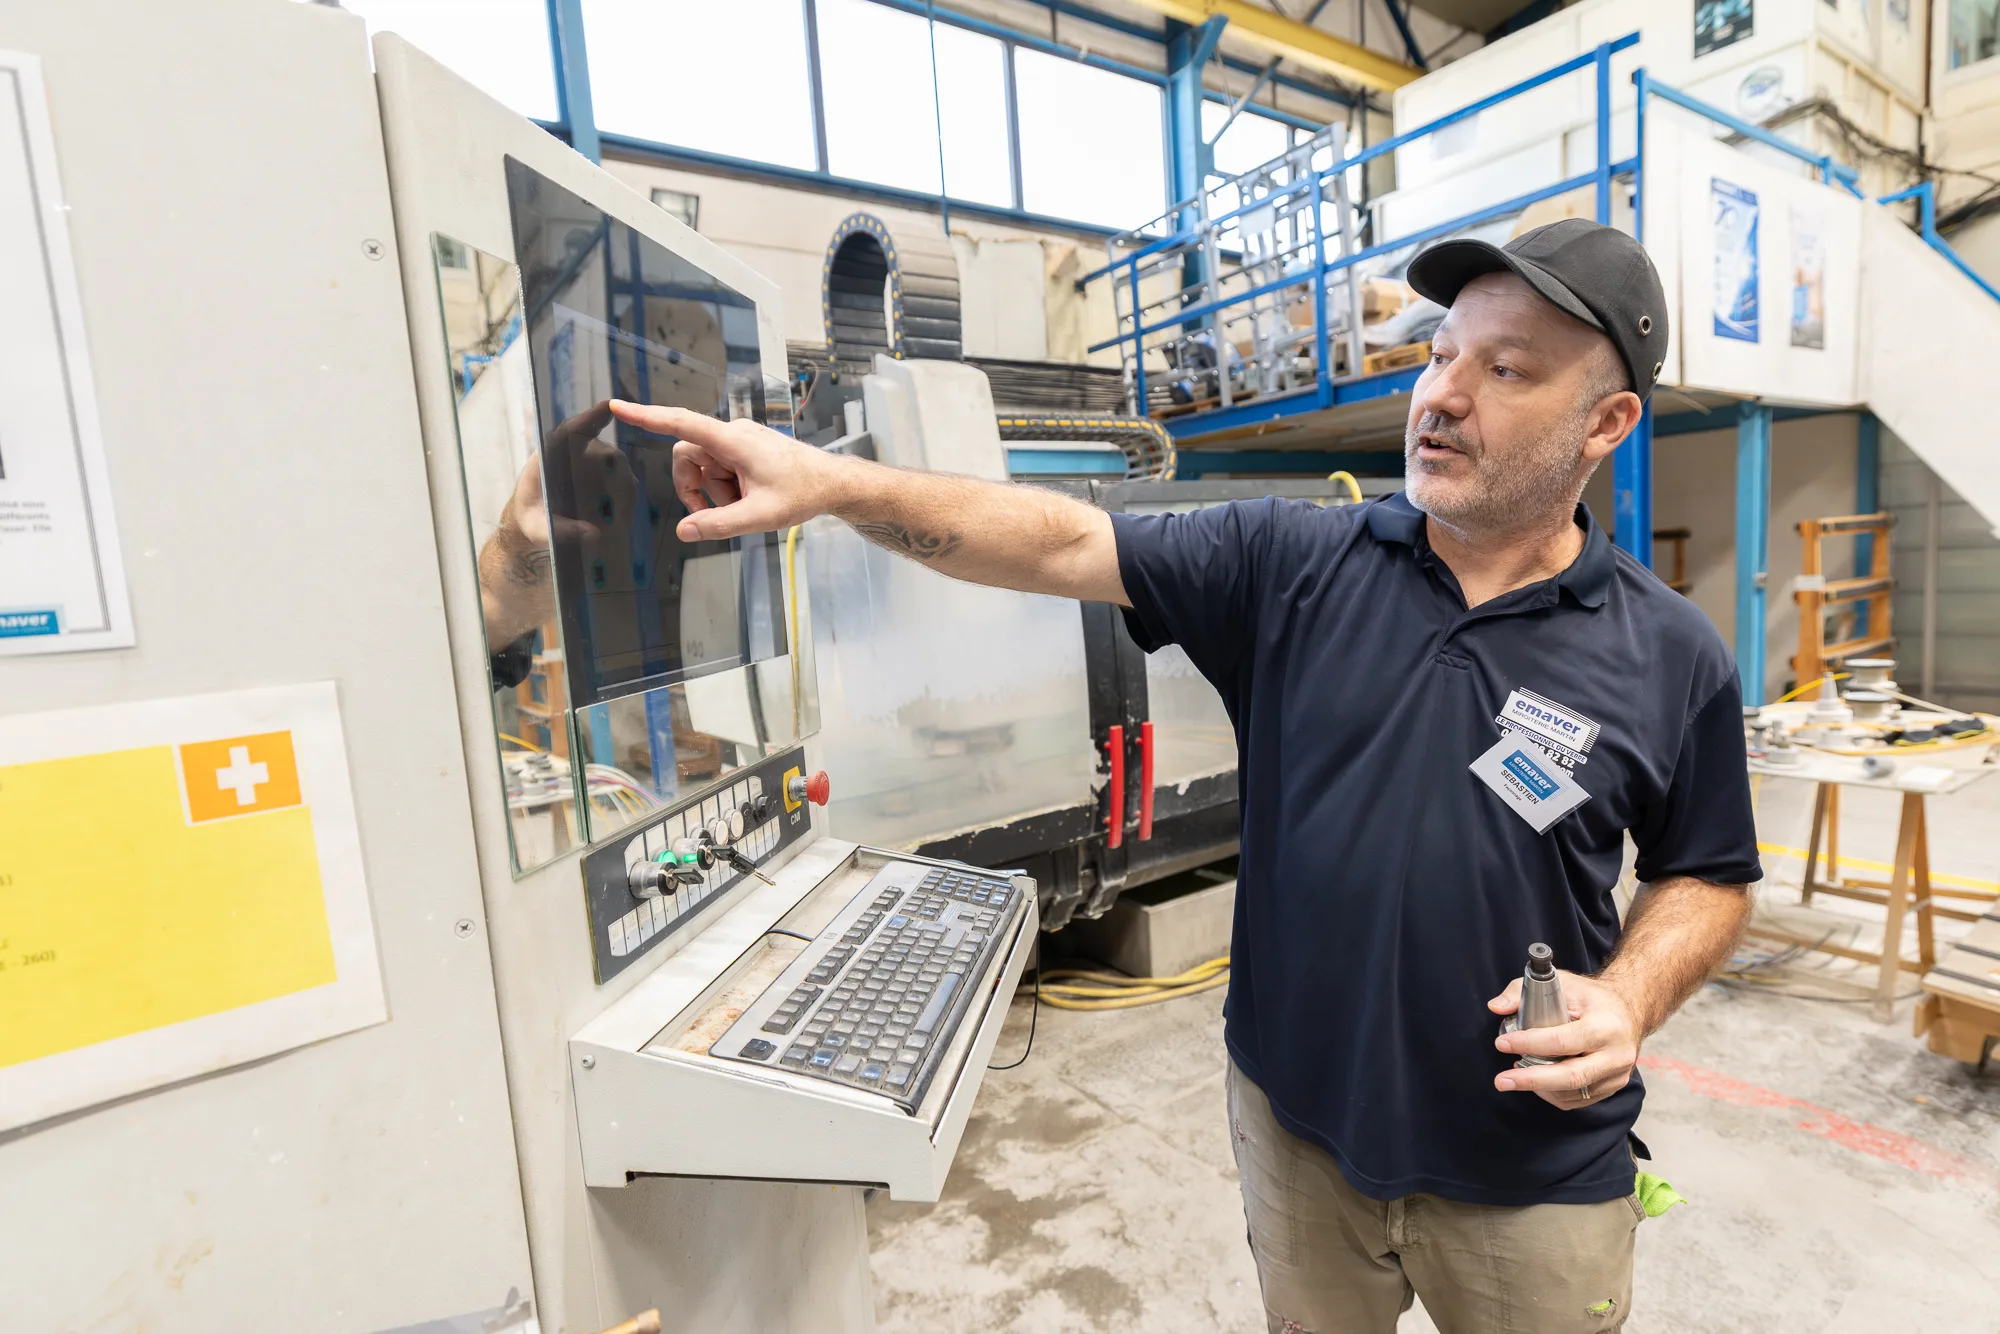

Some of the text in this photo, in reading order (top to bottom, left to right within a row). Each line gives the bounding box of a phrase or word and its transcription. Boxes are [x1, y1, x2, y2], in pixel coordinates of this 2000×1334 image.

[1511, 708, 1577, 742] MIROITERIE MARTIN
[1515, 700, 1581, 735] emaver
[1496, 716, 1506, 725] LE
[1555, 744, 1566, 753] DU
[1566, 749, 1587, 764] VERRE
[1513, 756, 1552, 790] emaver
[1546, 749, 1561, 763] 82
[1560, 755, 1576, 769] 82
[1500, 769, 1540, 805] SEBASTIEN
